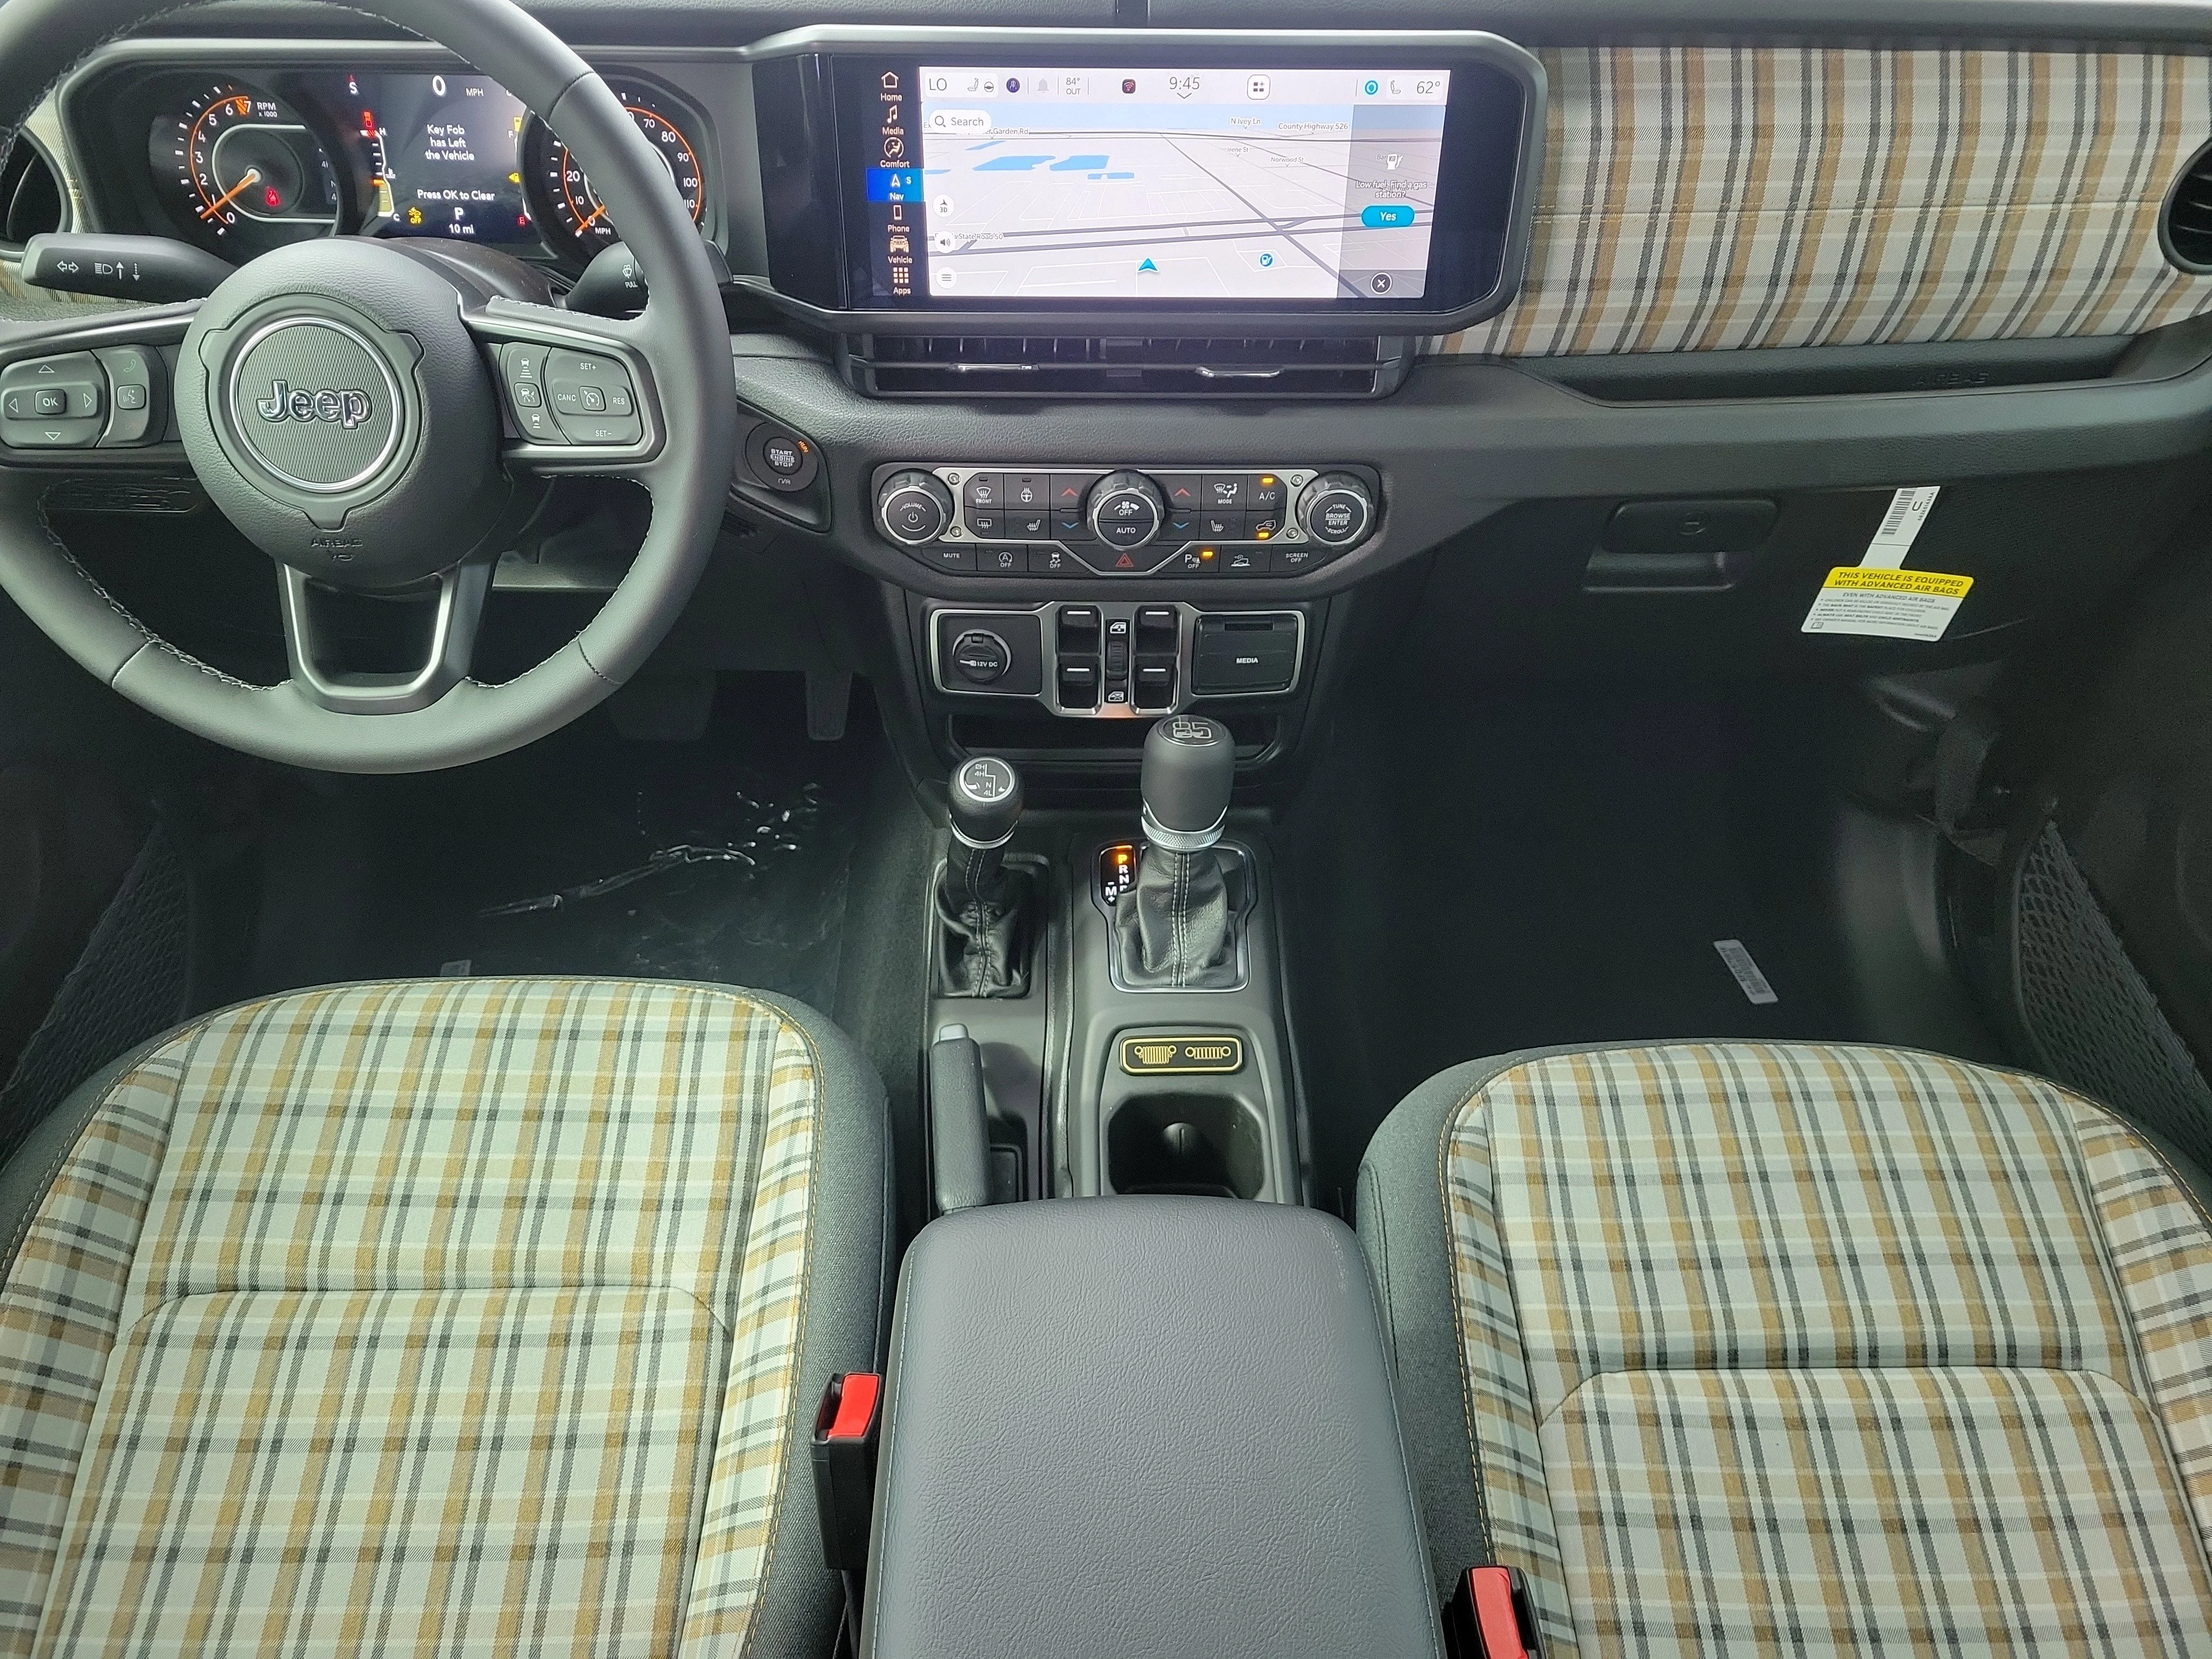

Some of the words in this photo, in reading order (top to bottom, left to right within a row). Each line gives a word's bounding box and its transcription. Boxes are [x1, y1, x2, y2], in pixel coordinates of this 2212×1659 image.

[432, 75, 445, 96] 0
[466, 88, 484, 97] MPH
[929, 78, 947, 91] LO
[1066, 77, 1080, 86] 84°
[1169, 77, 1200, 90] 9:45
[349, 82, 358, 95] S
[1417, 81, 1441, 94] 62°
[881, 93, 902, 101] Home
[225, 103, 233, 115] 6
[257, 102, 276, 111] RPM
[209, 114, 217, 126] 5
[644, 119, 656, 128] 70
[951, 117, 984, 126] Search
[379, 127, 386, 136] H
[427, 124, 444, 137] Key
[447, 125, 465, 135] Fob
[882, 127, 904, 135] Media
[1278, 123, 1302, 132] County
[1304, 122, 1334, 131] Highway
[198, 130, 206, 143] 4
[508, 130, 514, 139] F
[662, 131, 676, 143] 80
[430, 137, 447, 148] has
[448, 137, 466, 148] Left
[195, 151, 203, 163] 3
[425, 150, 440, 161] the
[442, 150, 475, 161] Vehicle
[677, 153, 689, 162] 90
[880, 160, 910, 168] Comfort
[199, 173, 208, 186] 2
[566, 170, 580, 182] 20
[683, 177, 698, 188] 100
[1356, 180, 1372, 189] Low
[1373, 180, 1390, 189] fuel.
[1390, 180, 1407, 189] Find
[1413, 182, 1427, 190] gas
[417, 190, 441, 200] Press
[443, 190, 458, 200] OK
[460, 190, 470, 200] to
[471, 191, 495, 201] Clear
[890, 193, 904, 201] Nav
[1375, 190, 1406, 199] station?
[575, 196, 584, 205] 10
[226, 212, 235, 224] 0
[454, 207, 464, 221] P
[1380, 211, 1397, 222] Yes
[449, 223, 460, 234] 10
[462, 223, 475, 234] mi
[595, 227, 611, 235] MPH
[888, 225, 910, 233] Phone
[625, 280, 638, 289] PULL
[893, 287, 911, 296] Apps
[42, 397, 58, 407] OK
[257, 380, 373, 430] Jeep
[770, 454, 795, 462] ENGINE
[1259, 492, 1276, 500] A/C
[1912, 501, 1923, 511] U
[1862, 572, 1902, 582] VEHICLE
[1915, 577, 1964, 588] EQUIPPED
[1859, 581, 1912, 590] ADVANCED
[1933, 586, 1960, 595] BAGS
[1118, 854, 1127, 864] P
[1119, 864, 1128, 874] R
[1119, 874, 1130, 884] N
[1105, 886, 1117, 896] M
